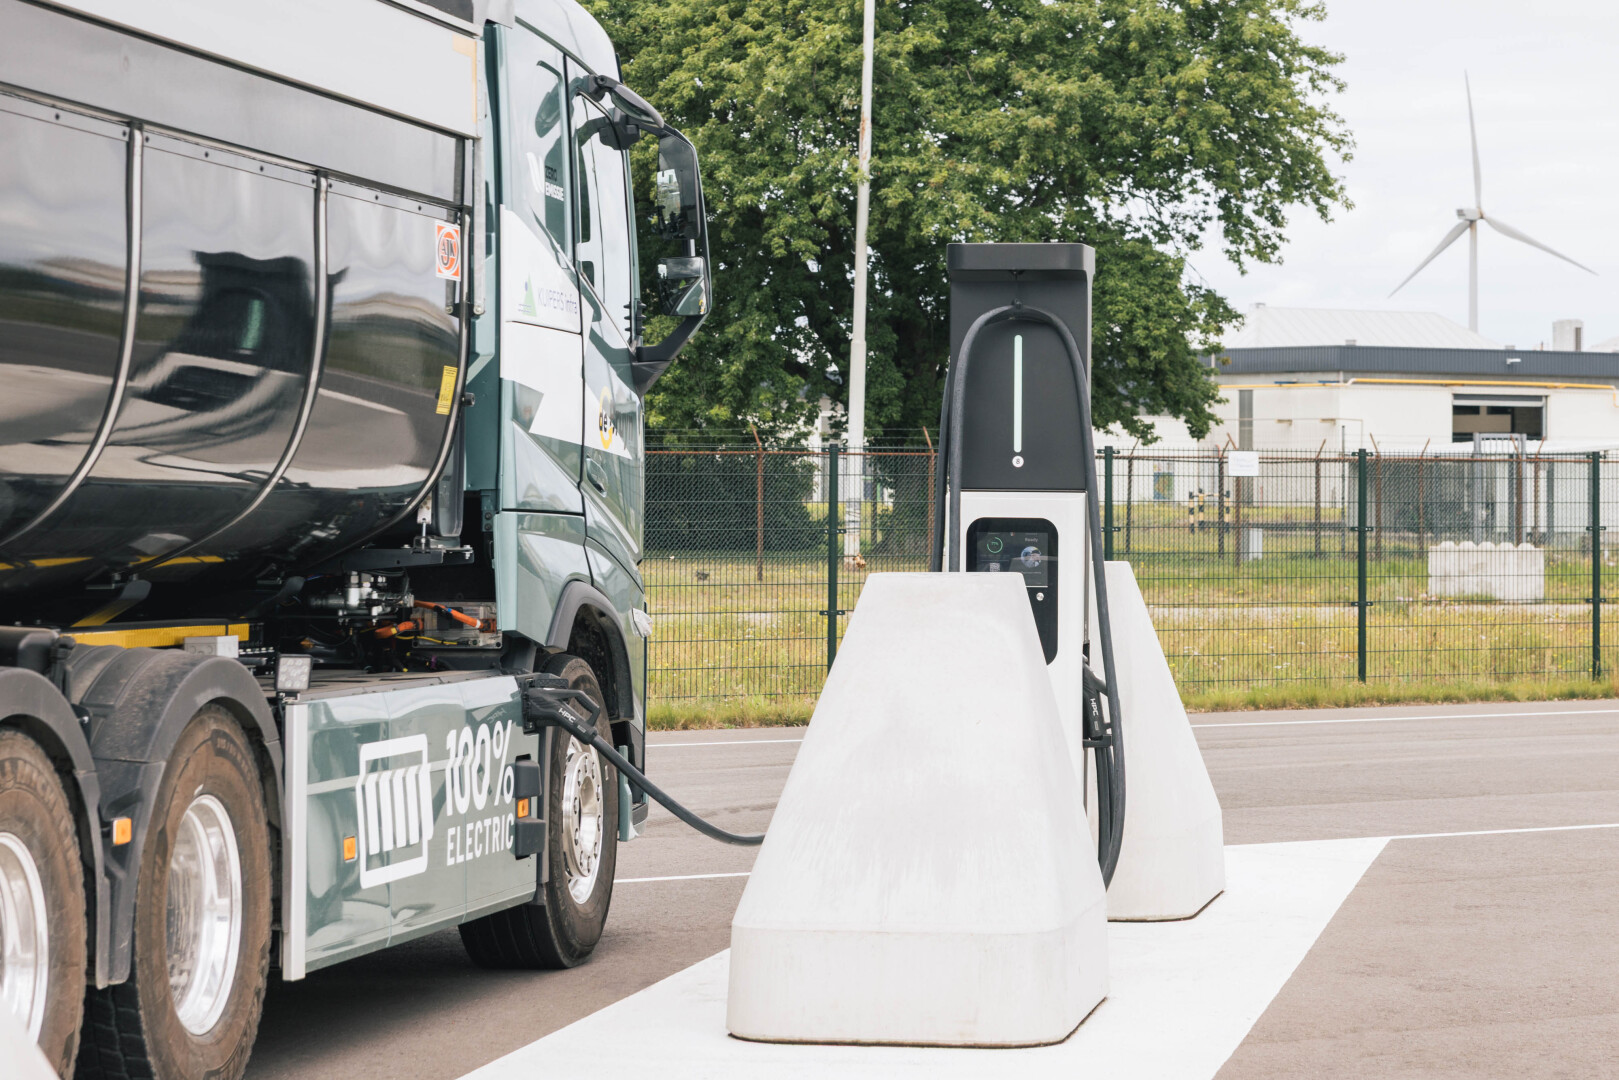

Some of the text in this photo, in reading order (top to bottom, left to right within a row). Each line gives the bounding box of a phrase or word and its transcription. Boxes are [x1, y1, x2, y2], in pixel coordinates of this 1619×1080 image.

[545, 165, 557, 181] ZERO
[545, 181, 564, 201] EMISSIE
[558, 707, 576, 723] HPC
[1090, 698, 1099, 717] HPC
[446, 719, 515, 816] 100%
[446, 812, 514, 866] ELECTRIC
